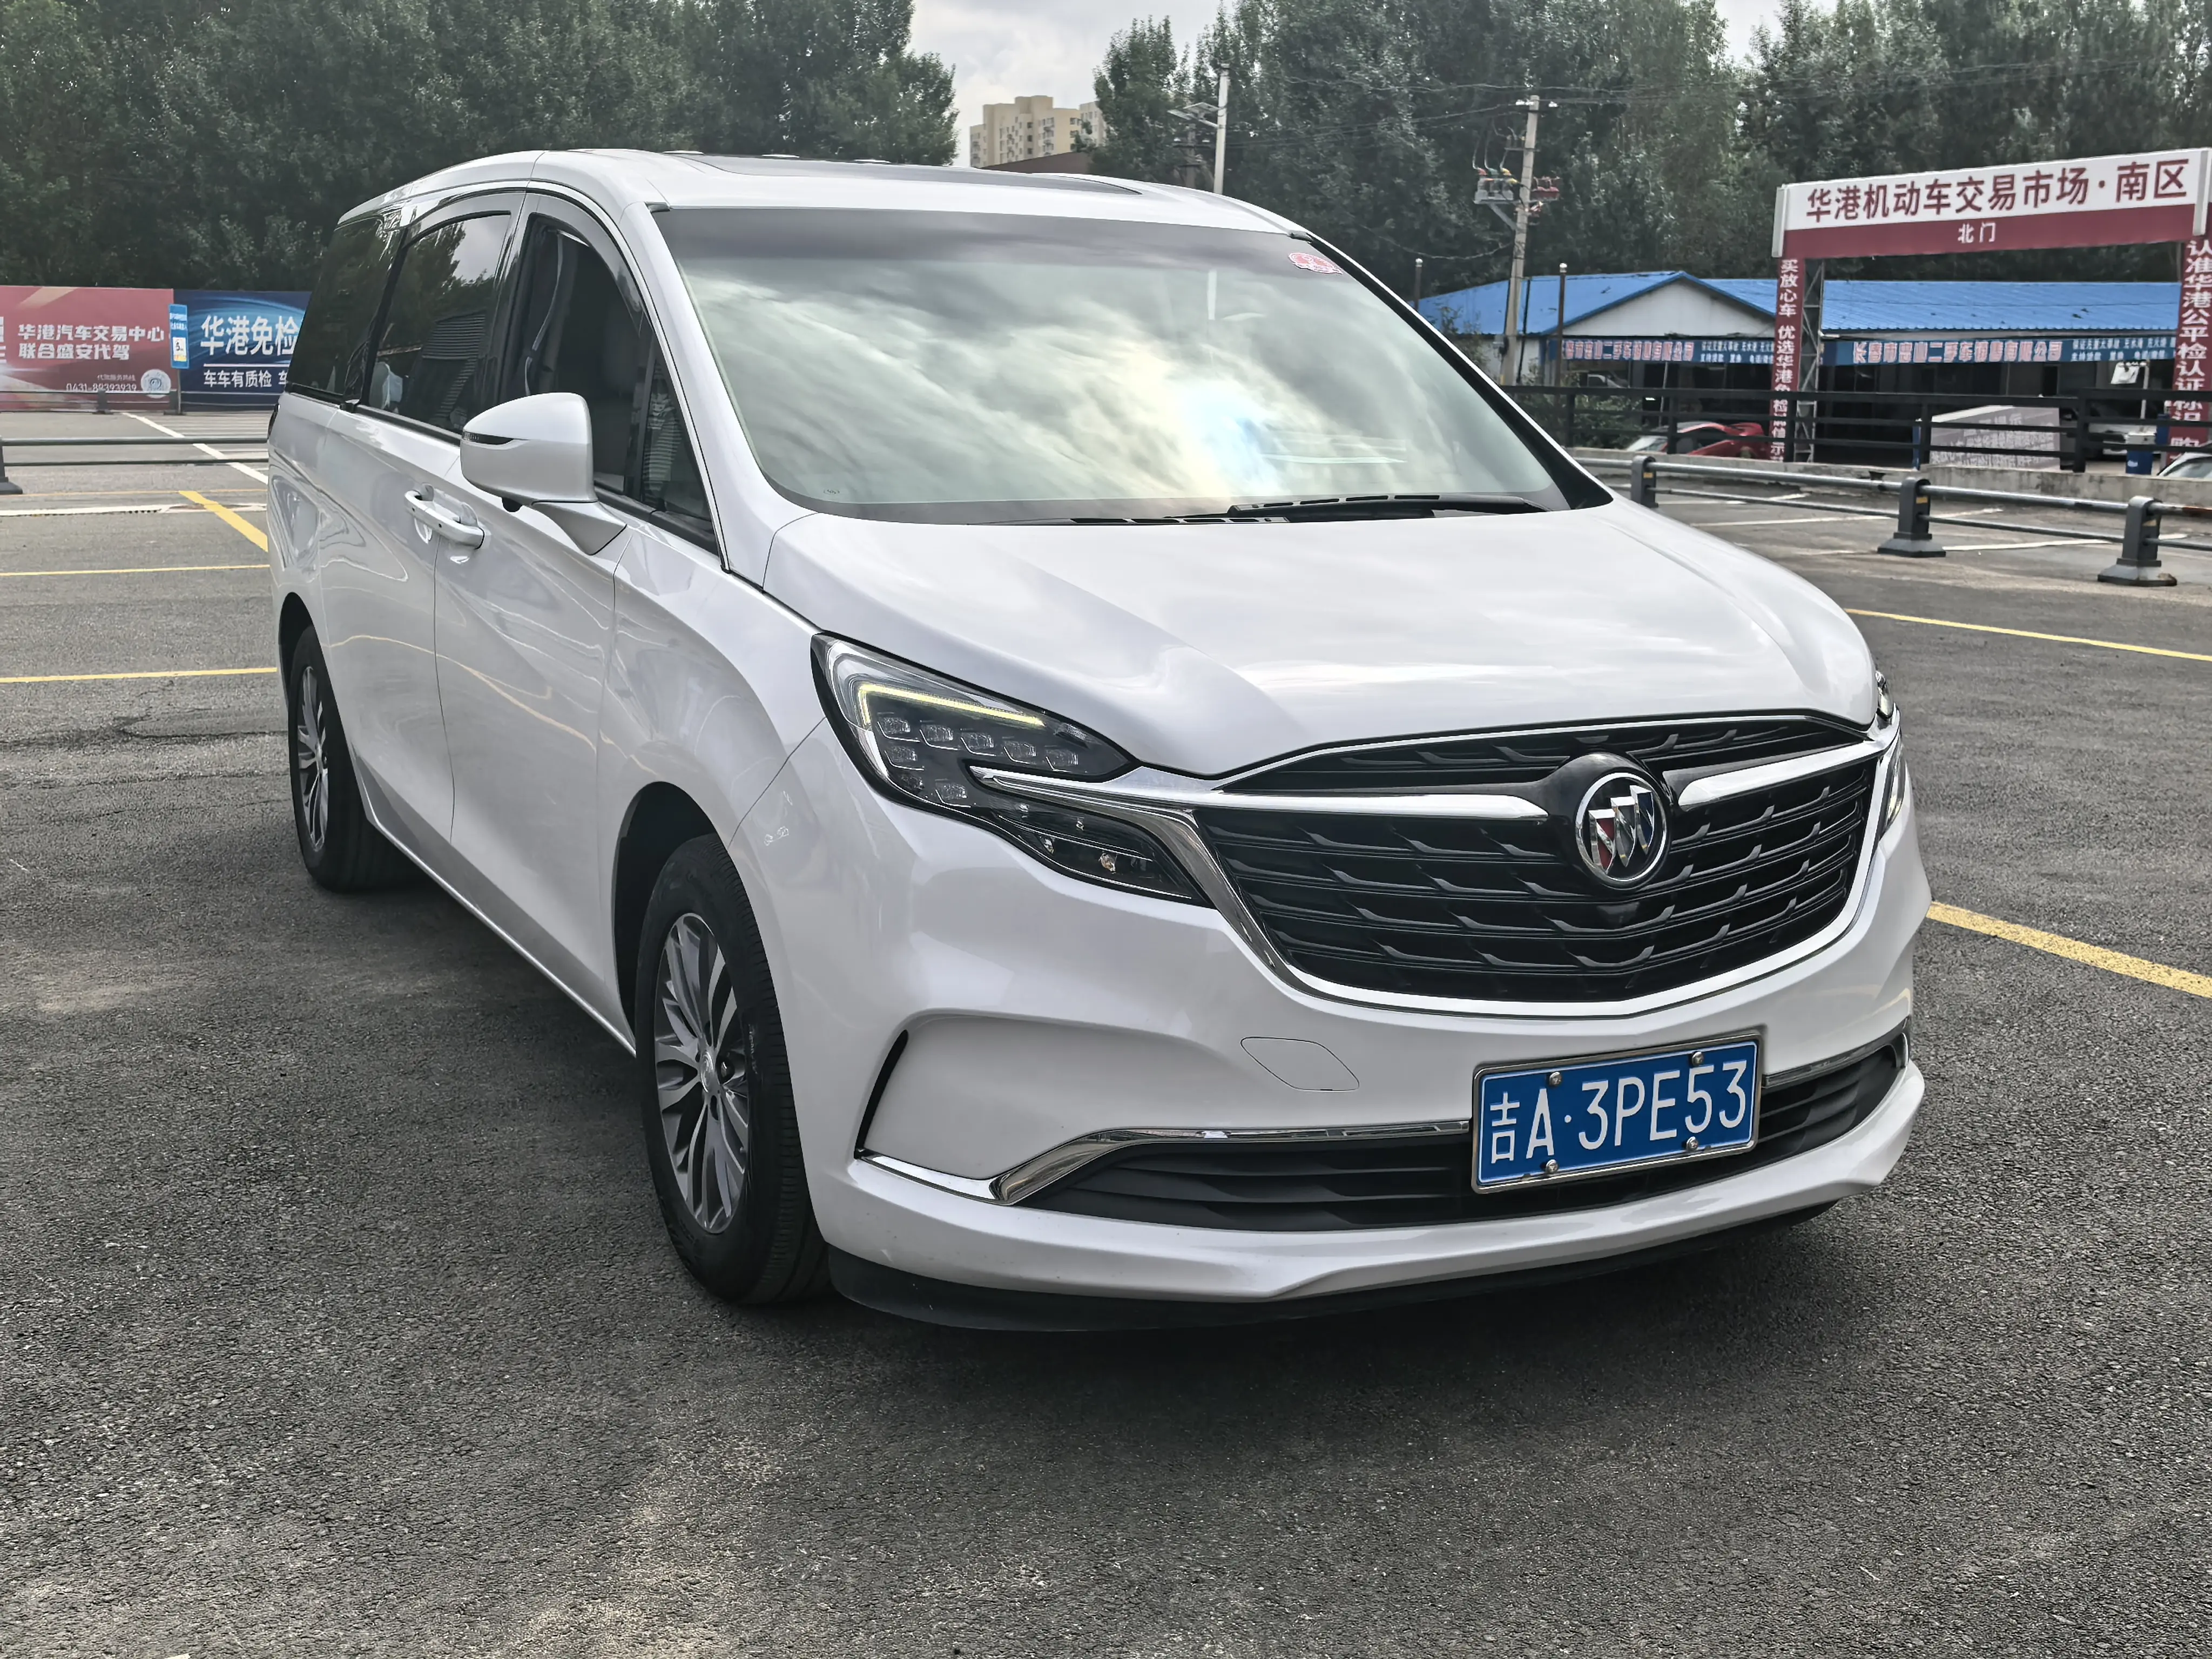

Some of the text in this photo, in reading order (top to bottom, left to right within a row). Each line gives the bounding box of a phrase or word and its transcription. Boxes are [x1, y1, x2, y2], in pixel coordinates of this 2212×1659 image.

[1805, 158, 2190, 223] 华港机动车交易市场·南区
[1957, 222, 1997, 244] 北门
[1779, 259, 1799, 318] 买放心车
[18, 324, 164, 341] 华港汽车交易中心
[200, 315, 299, 356] 华港免检
[18, 342, 130, 361] 联合盛安代驾
[204, 370, 272, 387] 车车有质检
[1490, 1060, 1748, 1164] 吉A·3PE53
